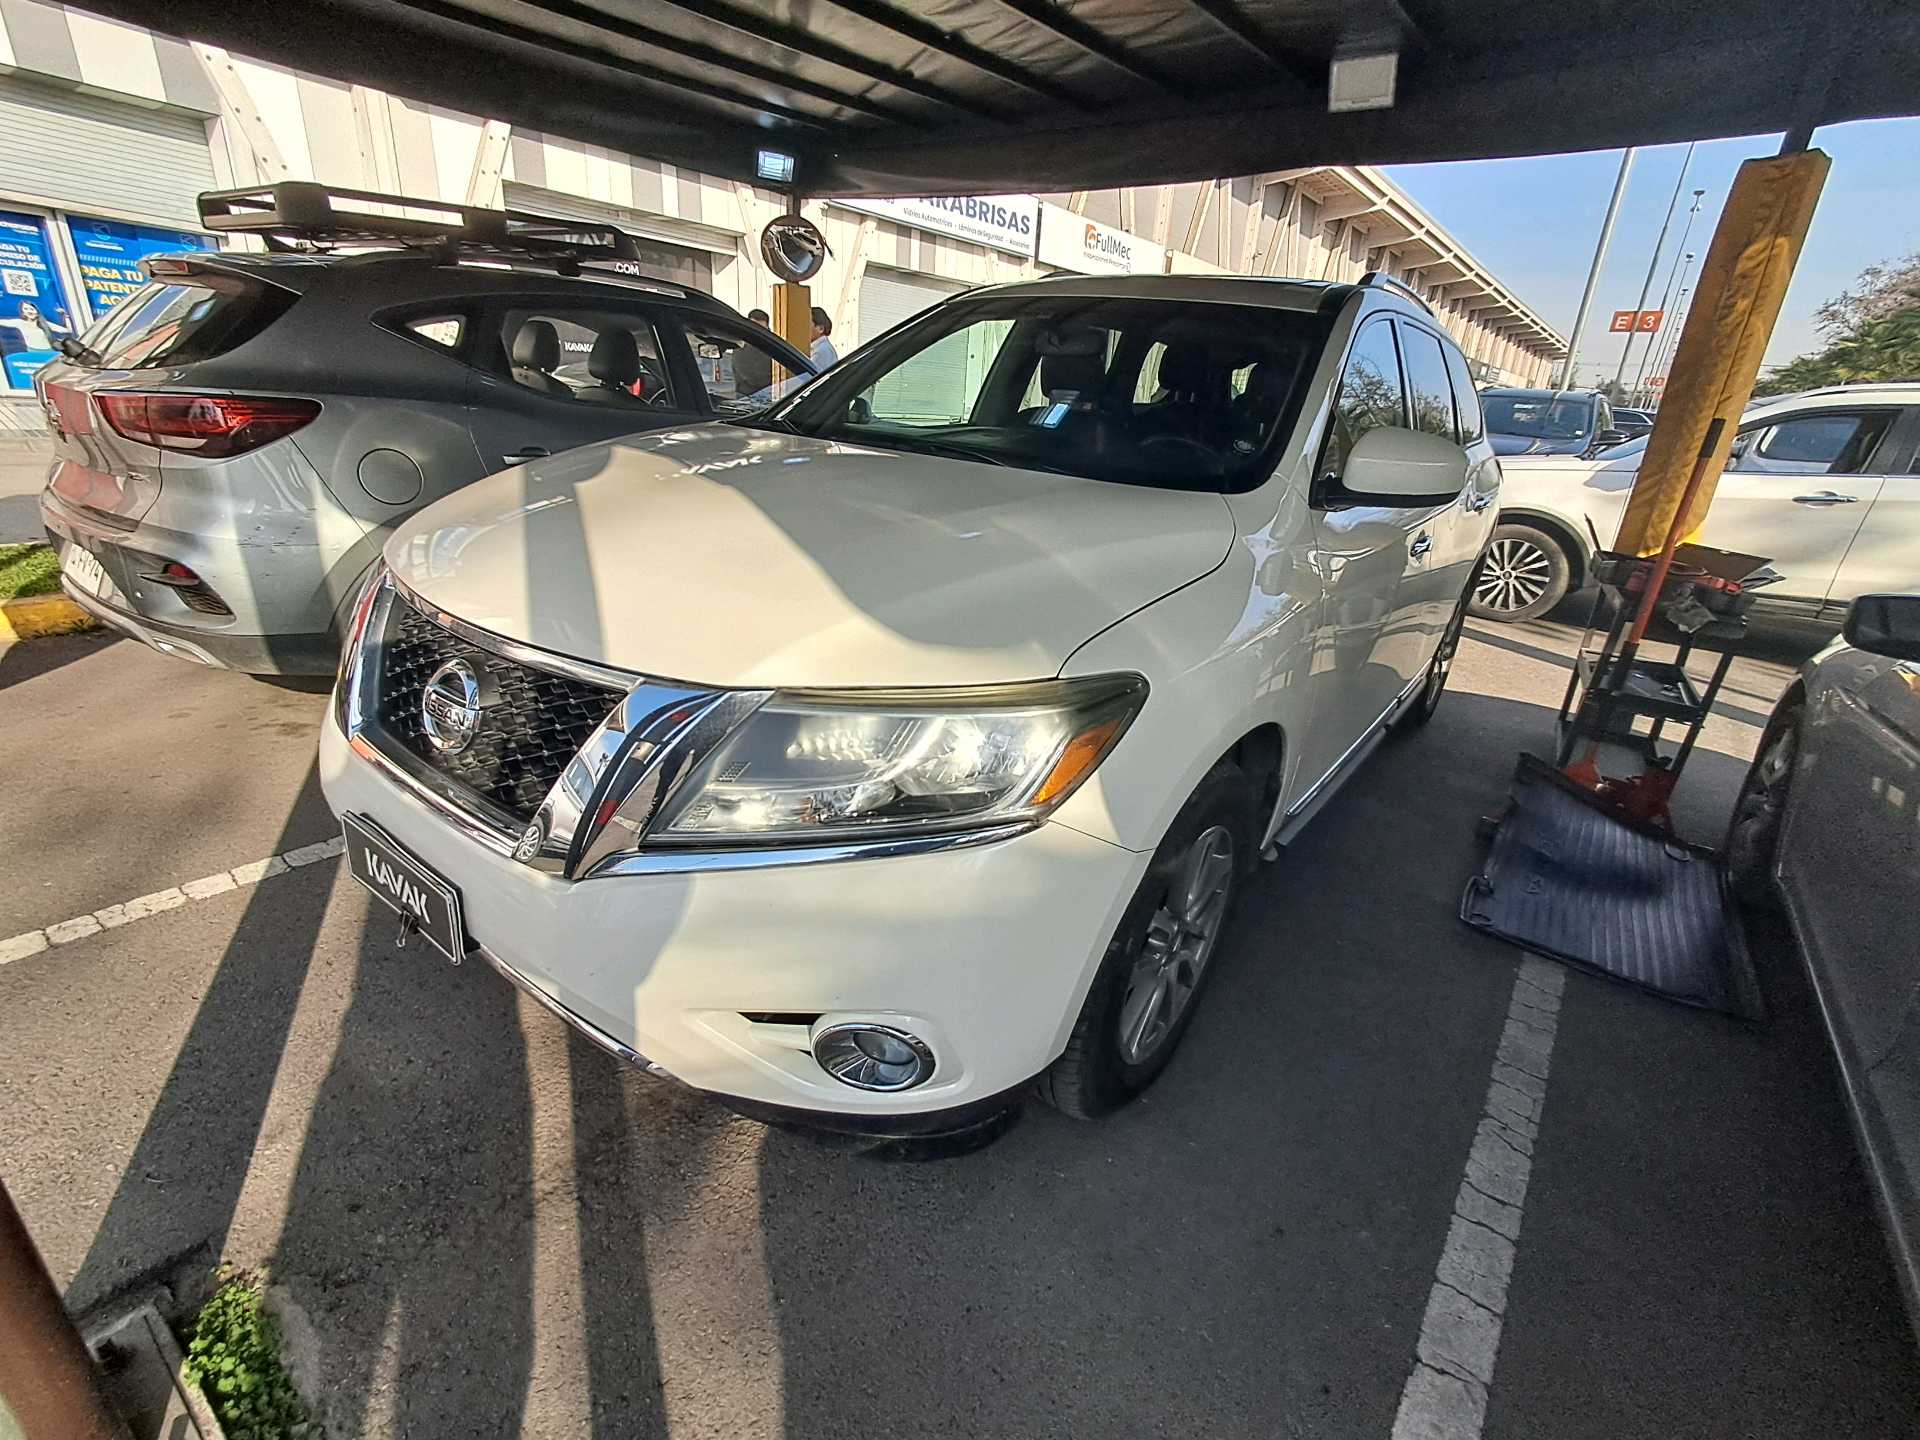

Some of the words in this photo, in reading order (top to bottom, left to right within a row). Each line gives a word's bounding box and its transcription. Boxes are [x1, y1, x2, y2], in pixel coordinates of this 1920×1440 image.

[1095, 232, 1131, 260] FullMec
[80, 265, 123, 280] PAGA
[123, 270, 144, 283] TU
[1615, 316, 1630, 330] E
[1643, 315, 1655, 329] 3
[364, 847, 432, 925] KAVAK
